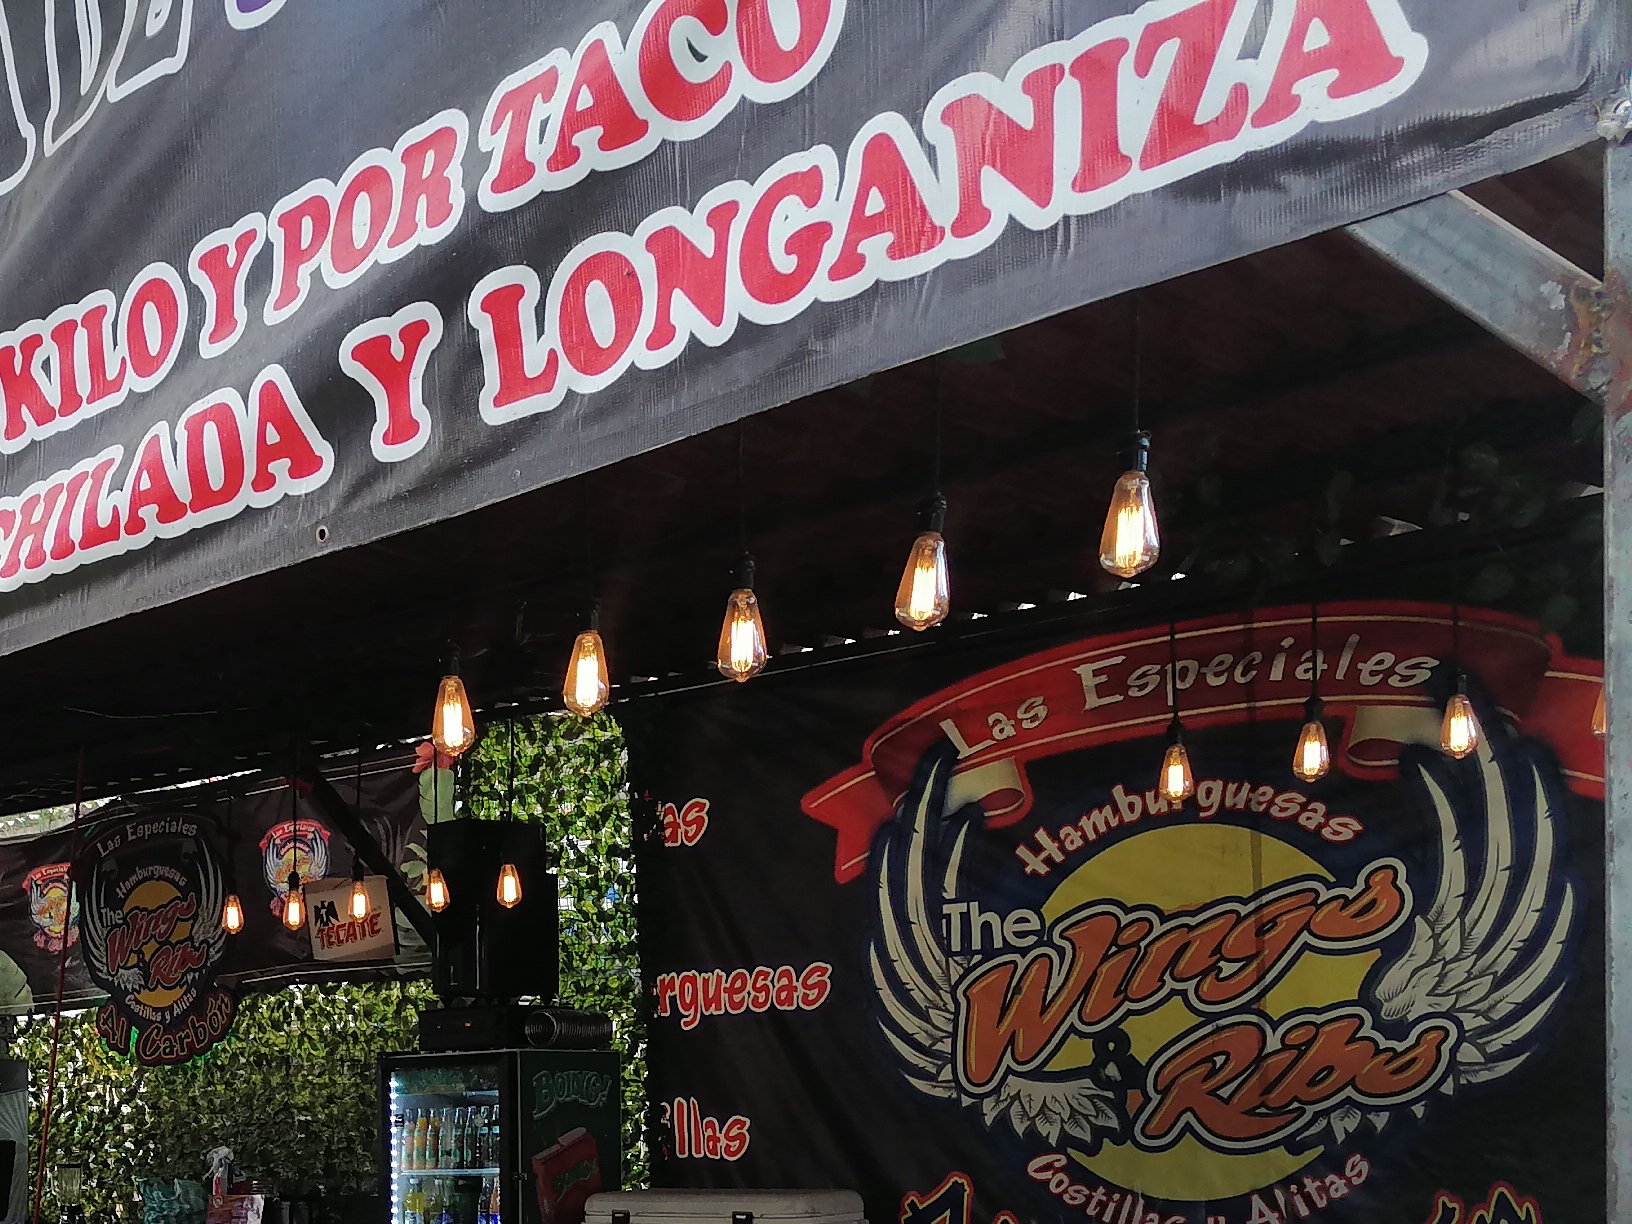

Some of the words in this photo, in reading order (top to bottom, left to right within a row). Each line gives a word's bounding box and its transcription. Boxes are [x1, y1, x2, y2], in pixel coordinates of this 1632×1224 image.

[192, 215, 264, 355] Y
[267, 112, 464, 322] POR
[480, 0, 846, 213] TACO
[339, 301, 443, 463] Y
[470, 0, 1429, 424] LONGANIZA
[939, 695, 1048, 760] Las
[1073, 633, 1441, 712] Especiales
[96, 834, 121, 858] Las
[126, 817, 197, 841] Especiales
[1015, 778, 1363, 878] Hambuguesas
[116, 865, 188, 899] Hamburguesas
[101, 906, 124, 928] The
[107, 892, 197, 974] Wings
[316, 912, 382, 950] TECATE
[942, 903, 1042, 953] The
[148, 941, 208, 988] Ribs
[953, 858, 1408, 1096] Wings
[100, 1004, 127, 1048] Al
[140, 993, 233, 1060] Carbón
[125, 994, 162, 1021] Costillas
[173, 988, 197, 1017] Alitas
[1134, 1006, 1460, 1151] Ribs
